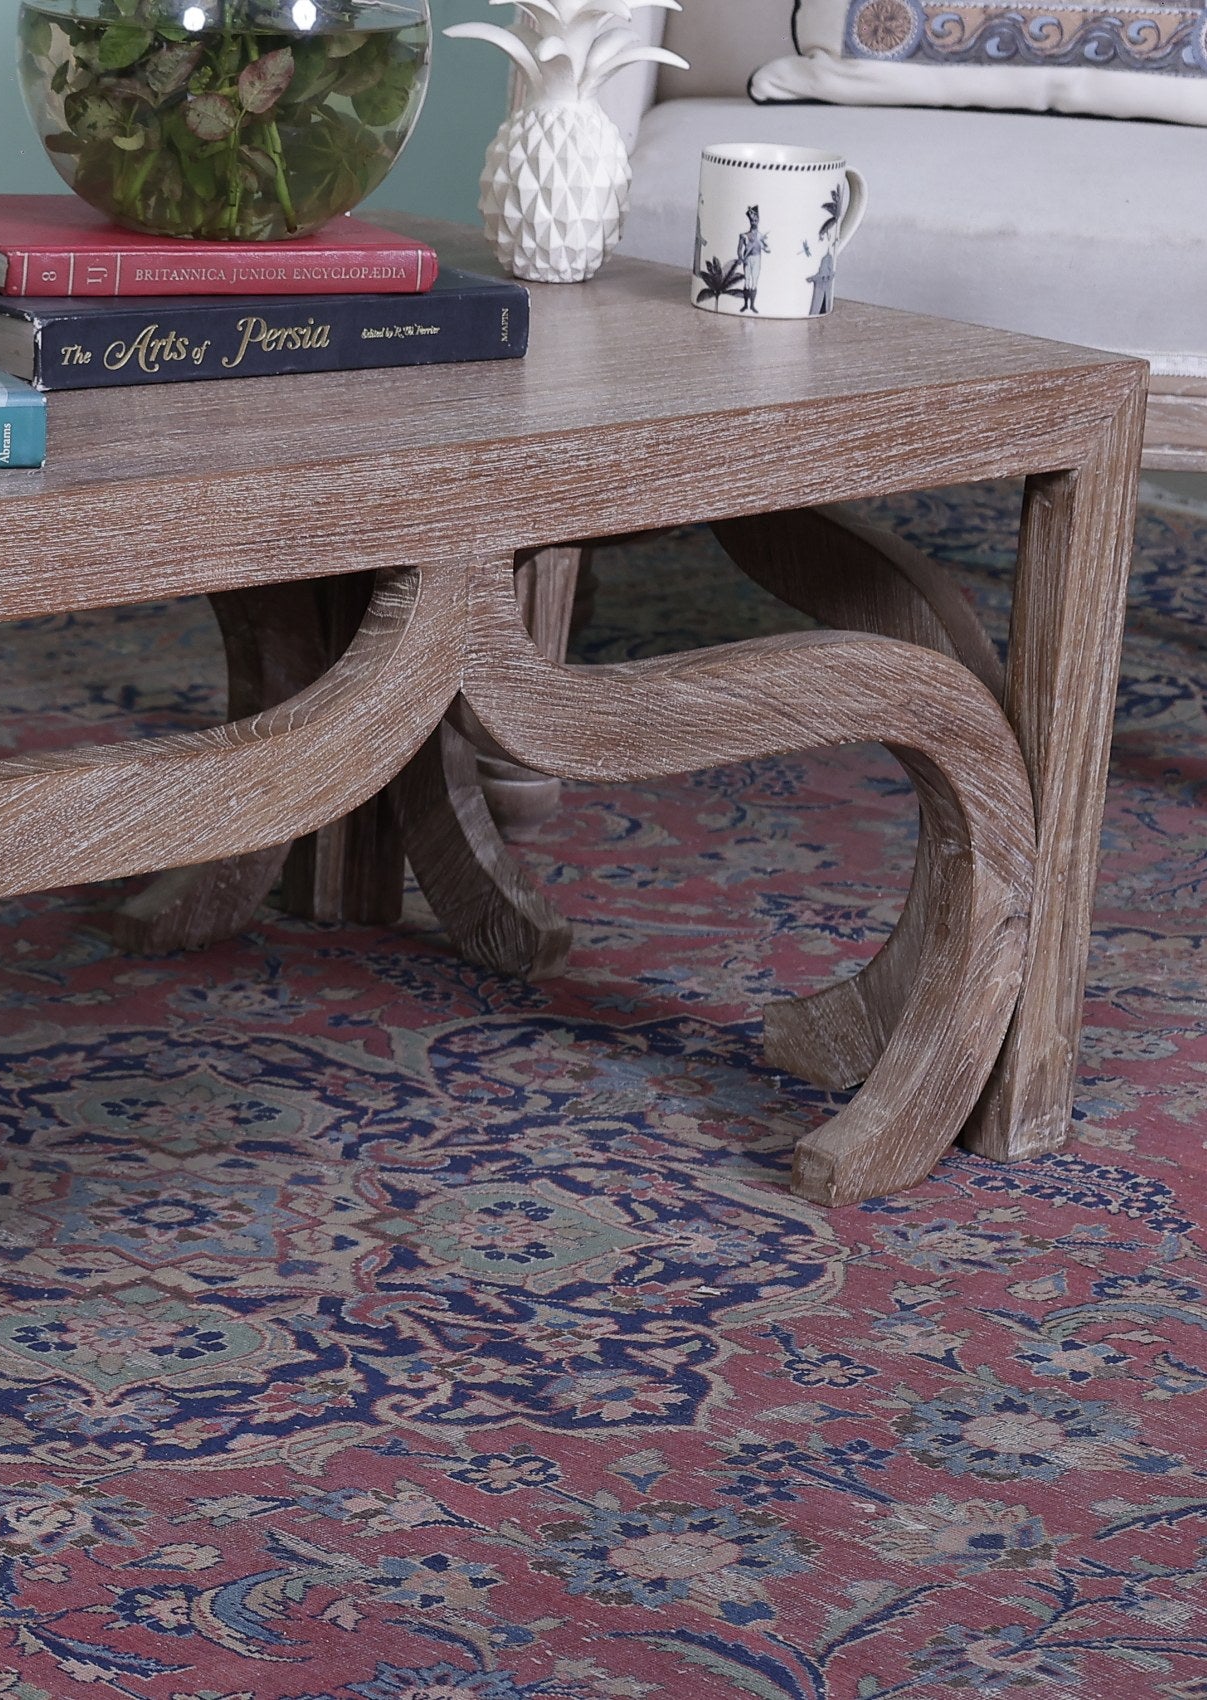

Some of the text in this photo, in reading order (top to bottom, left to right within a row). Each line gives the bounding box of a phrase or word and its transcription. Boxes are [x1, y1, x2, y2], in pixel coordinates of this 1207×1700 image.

[41, 270, 57, 282] 8
[135, 268, 227, 281] BRITANNICA
[230, 267, 287, 284] JUNIOR
[501, 307, 510, 343] MAPIN
[61, 316, 332, 373] The Arts of Persia
